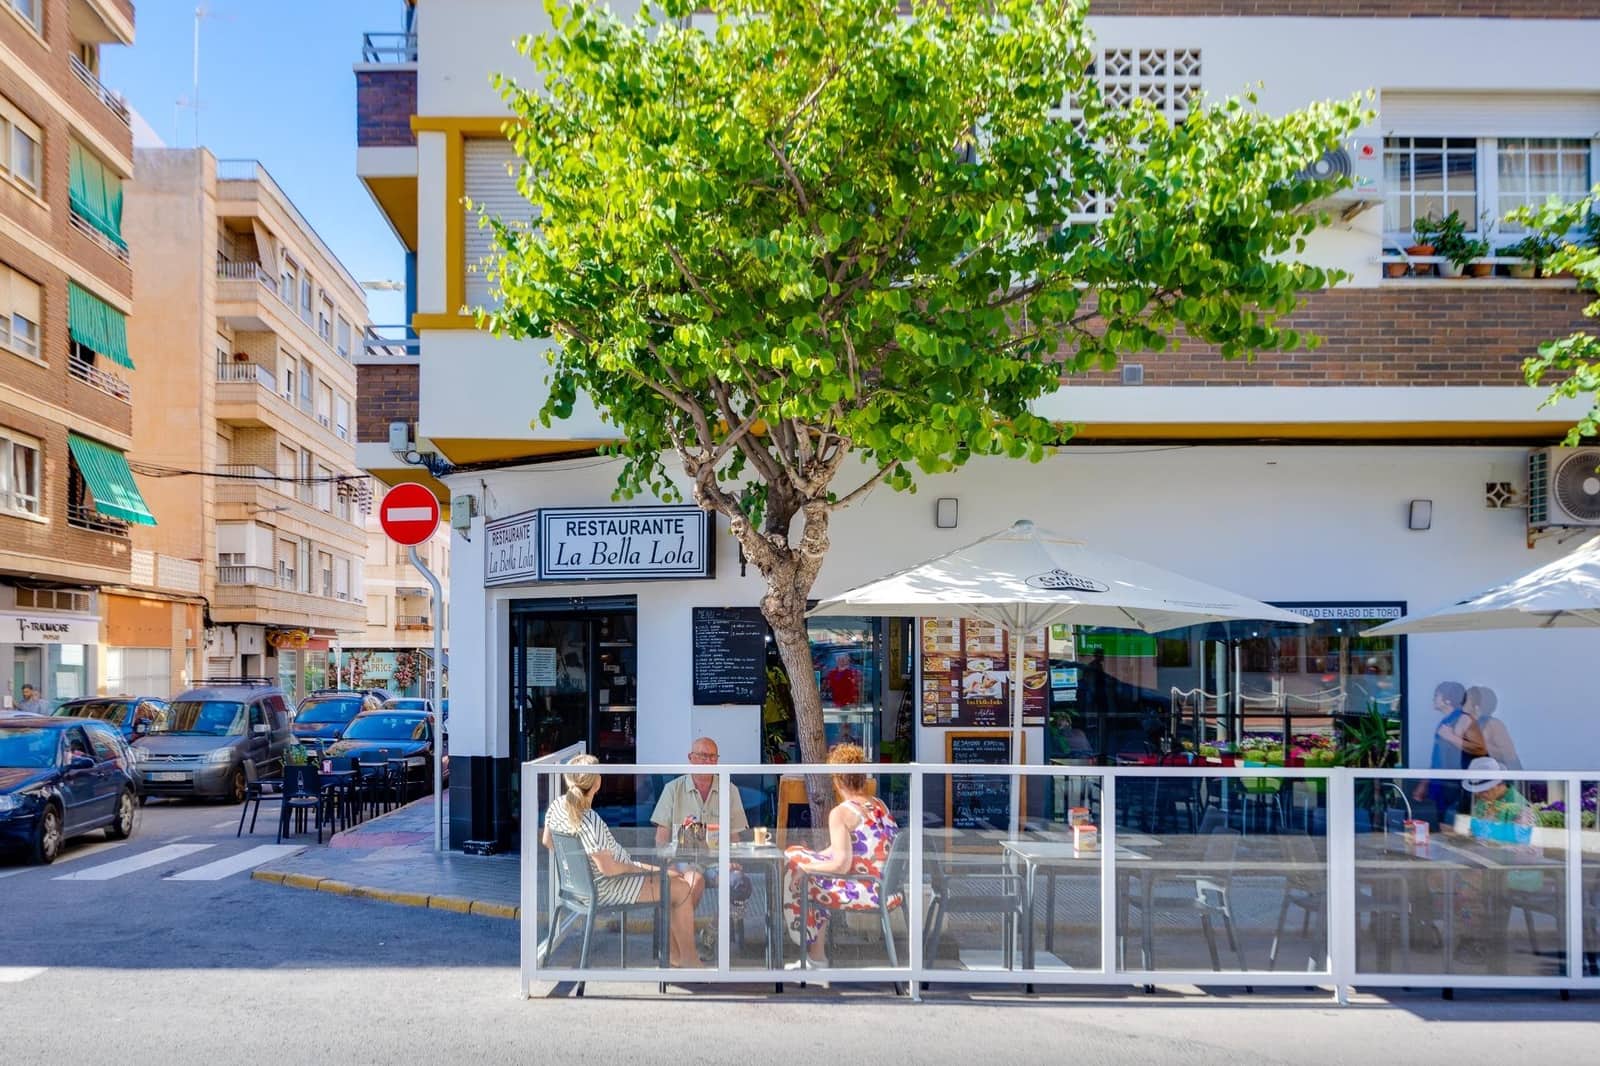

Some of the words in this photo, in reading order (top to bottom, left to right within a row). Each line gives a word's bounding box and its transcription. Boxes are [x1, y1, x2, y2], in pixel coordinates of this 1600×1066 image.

[492, 524, 531, 546] RESTAURANTE
[566, 518, 685, 537] RESTAURANTE
[555, 542, 582, 566] La
[589, 537, 641, 565] Bella
[648, 536, 695, 564] Lola
[1322, 608, 1335, 617] EN
[1336, 608, 1360, 617] RABO
[1363, 608, 1375, 617] DE
[1377, 608, 1400, 617] TORO
